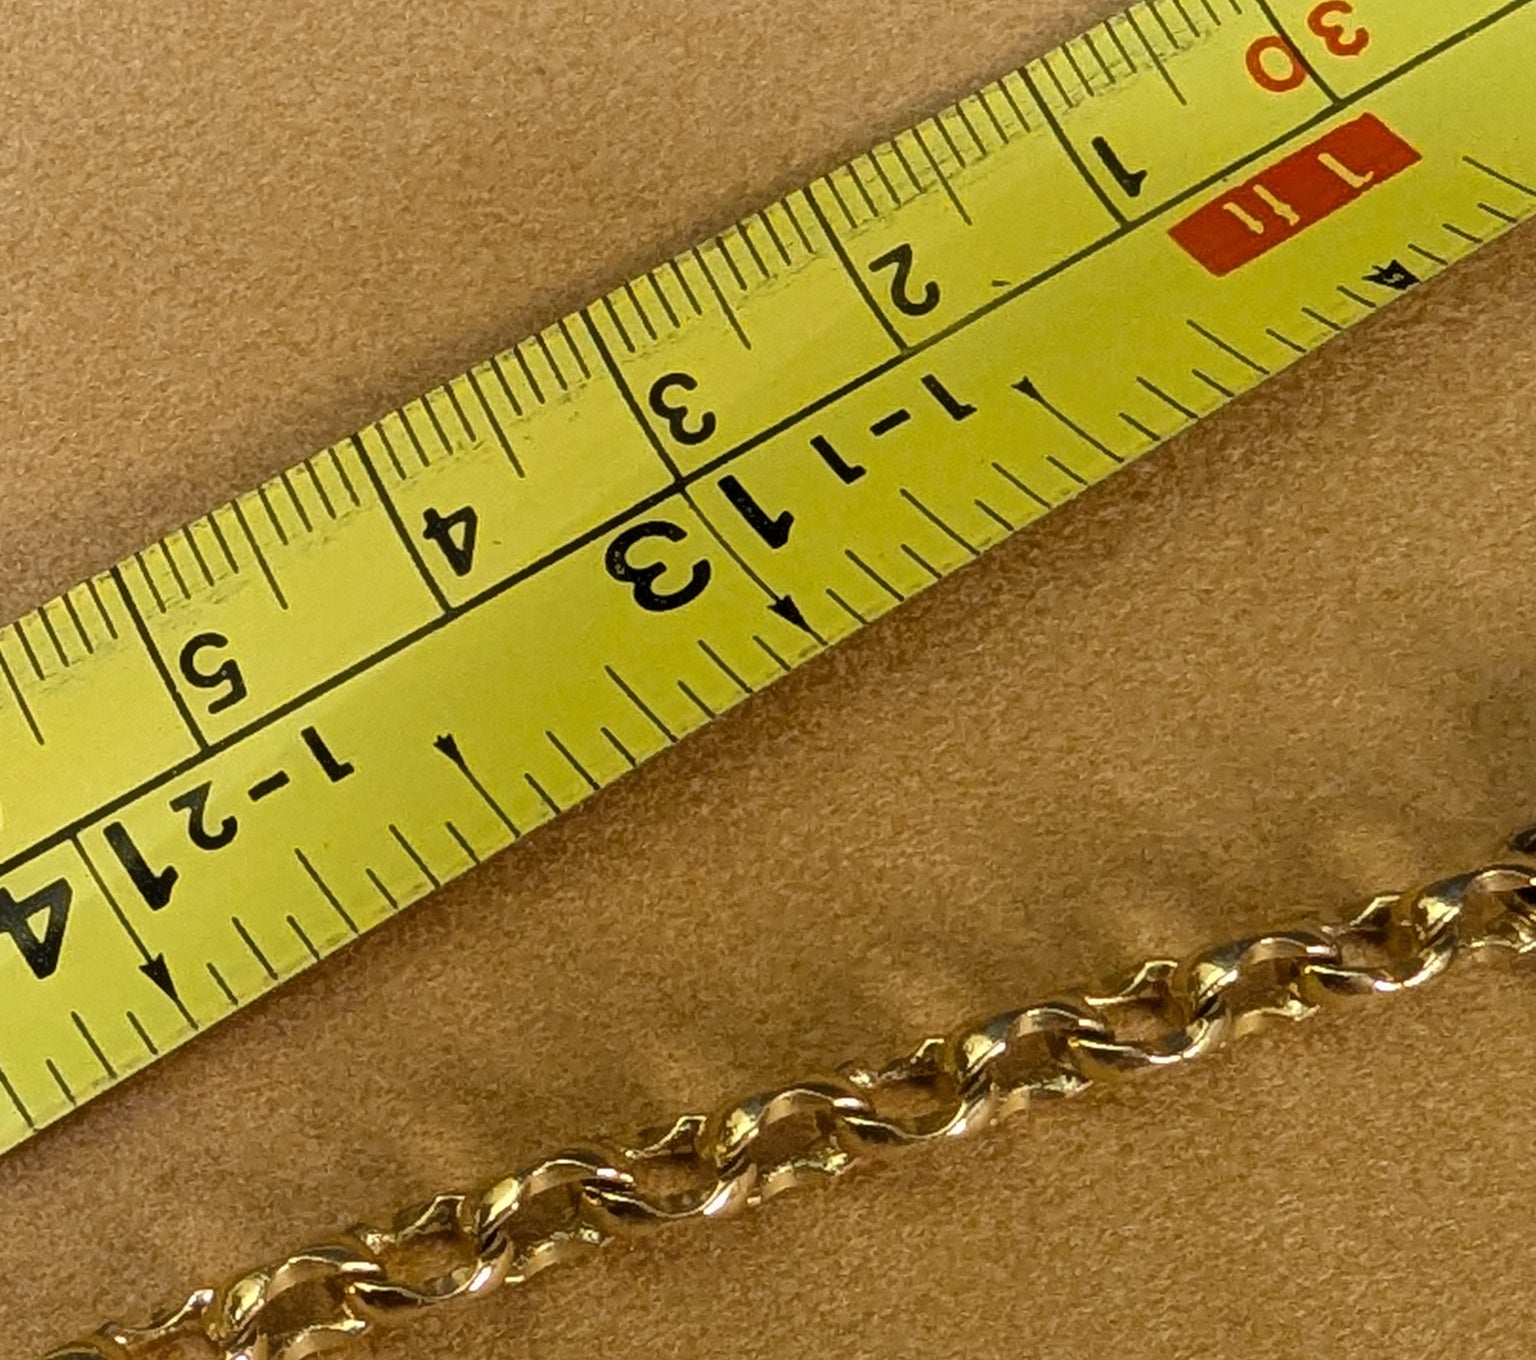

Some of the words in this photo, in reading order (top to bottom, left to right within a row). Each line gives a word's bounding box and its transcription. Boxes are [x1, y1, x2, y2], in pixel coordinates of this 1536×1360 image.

[1245, 0, 1369, 92] 30
[1092, 137, 1147, 197] 1
[869, 243, 940, 316] 2
[649, 373, 716, 445] 3
[423, 506, 478, 576] 4
[605, 475, 795, 612] 13
[179, 632, 248, 715] 5
